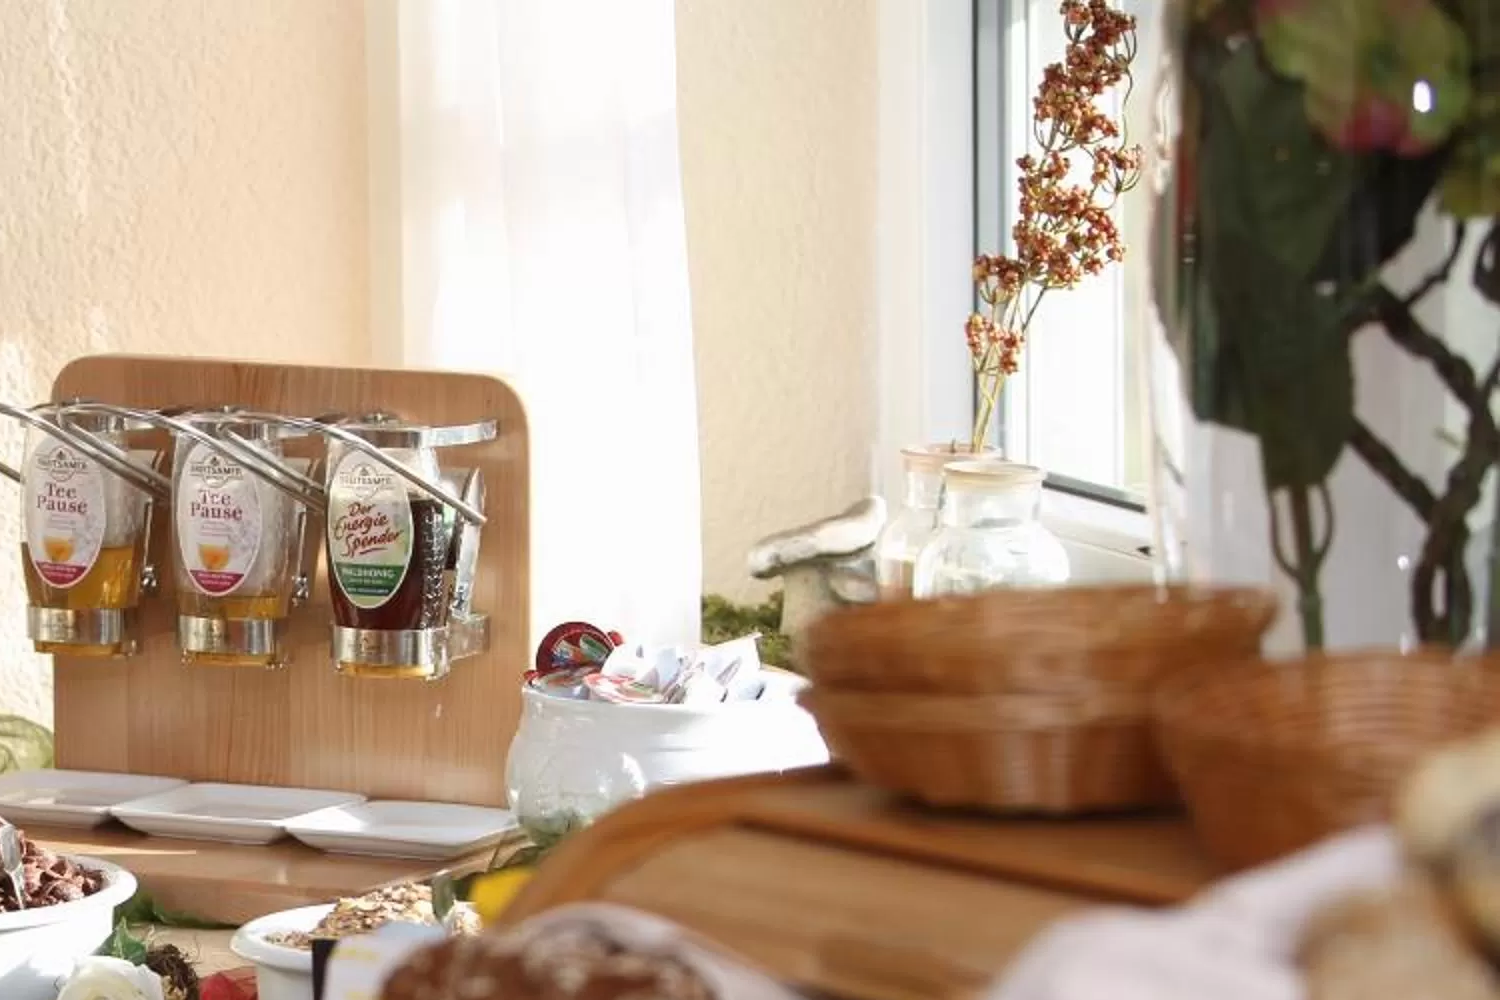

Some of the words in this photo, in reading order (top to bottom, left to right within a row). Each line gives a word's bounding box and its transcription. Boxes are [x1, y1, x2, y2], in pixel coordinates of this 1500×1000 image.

[44, 482, 77, 499] Tee
[198, 489, 232, 505] Tee
[36, 495, 88, 515] Pause
[189, 500, 243, 521] Pause
[348, 501, 375, 517] Der
[334, 511, 389, 541] Energie
[341, 527, 404, 558] Spender
